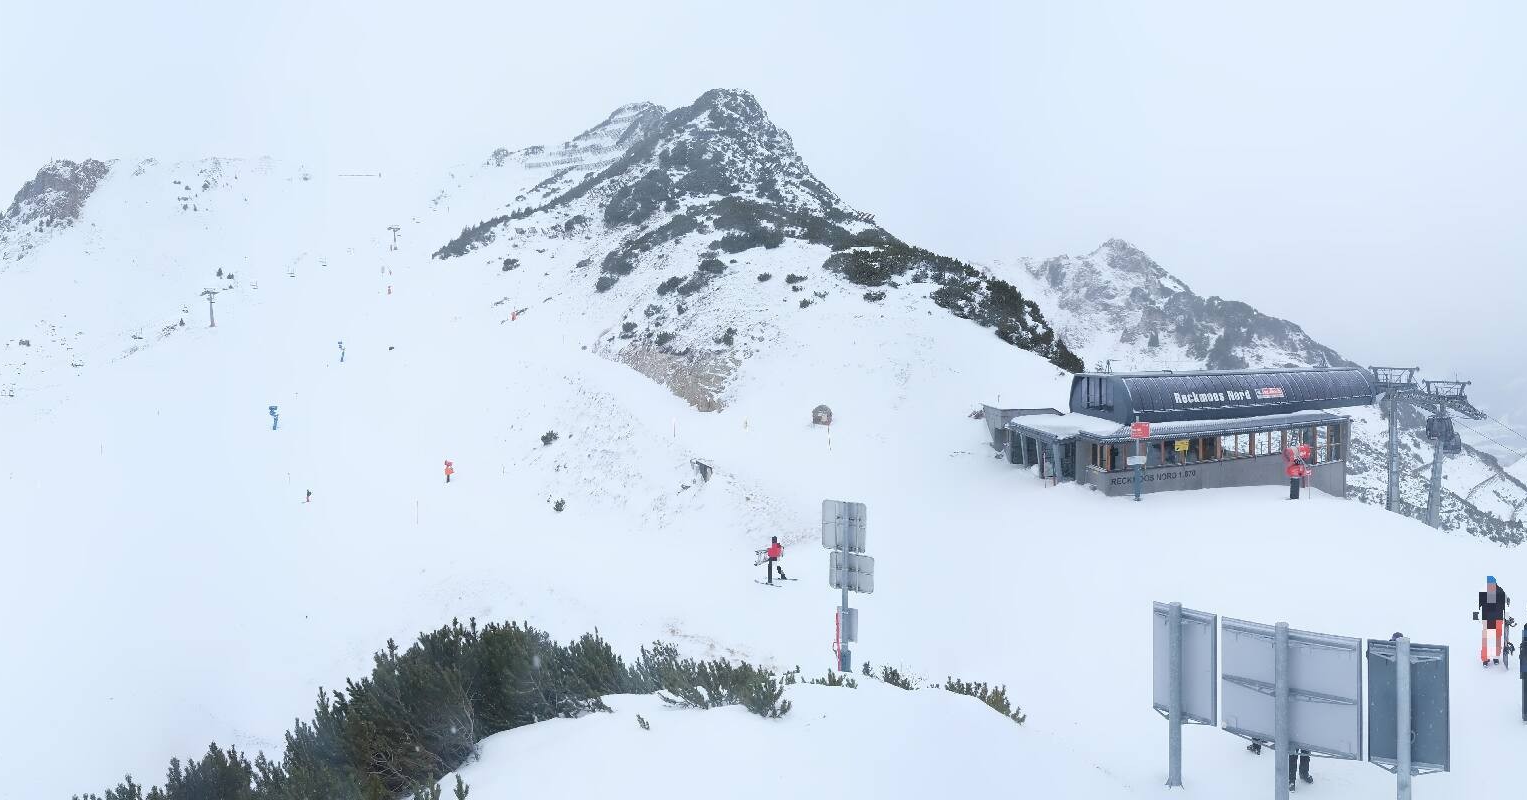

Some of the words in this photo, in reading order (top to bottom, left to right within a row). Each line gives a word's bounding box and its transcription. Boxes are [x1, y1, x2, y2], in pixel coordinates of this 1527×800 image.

[1226, 390, 1252, 401] Nord
[1111, 474, 1154, 486] RECKOS
[1156, 472, 1177, 481] NORD
